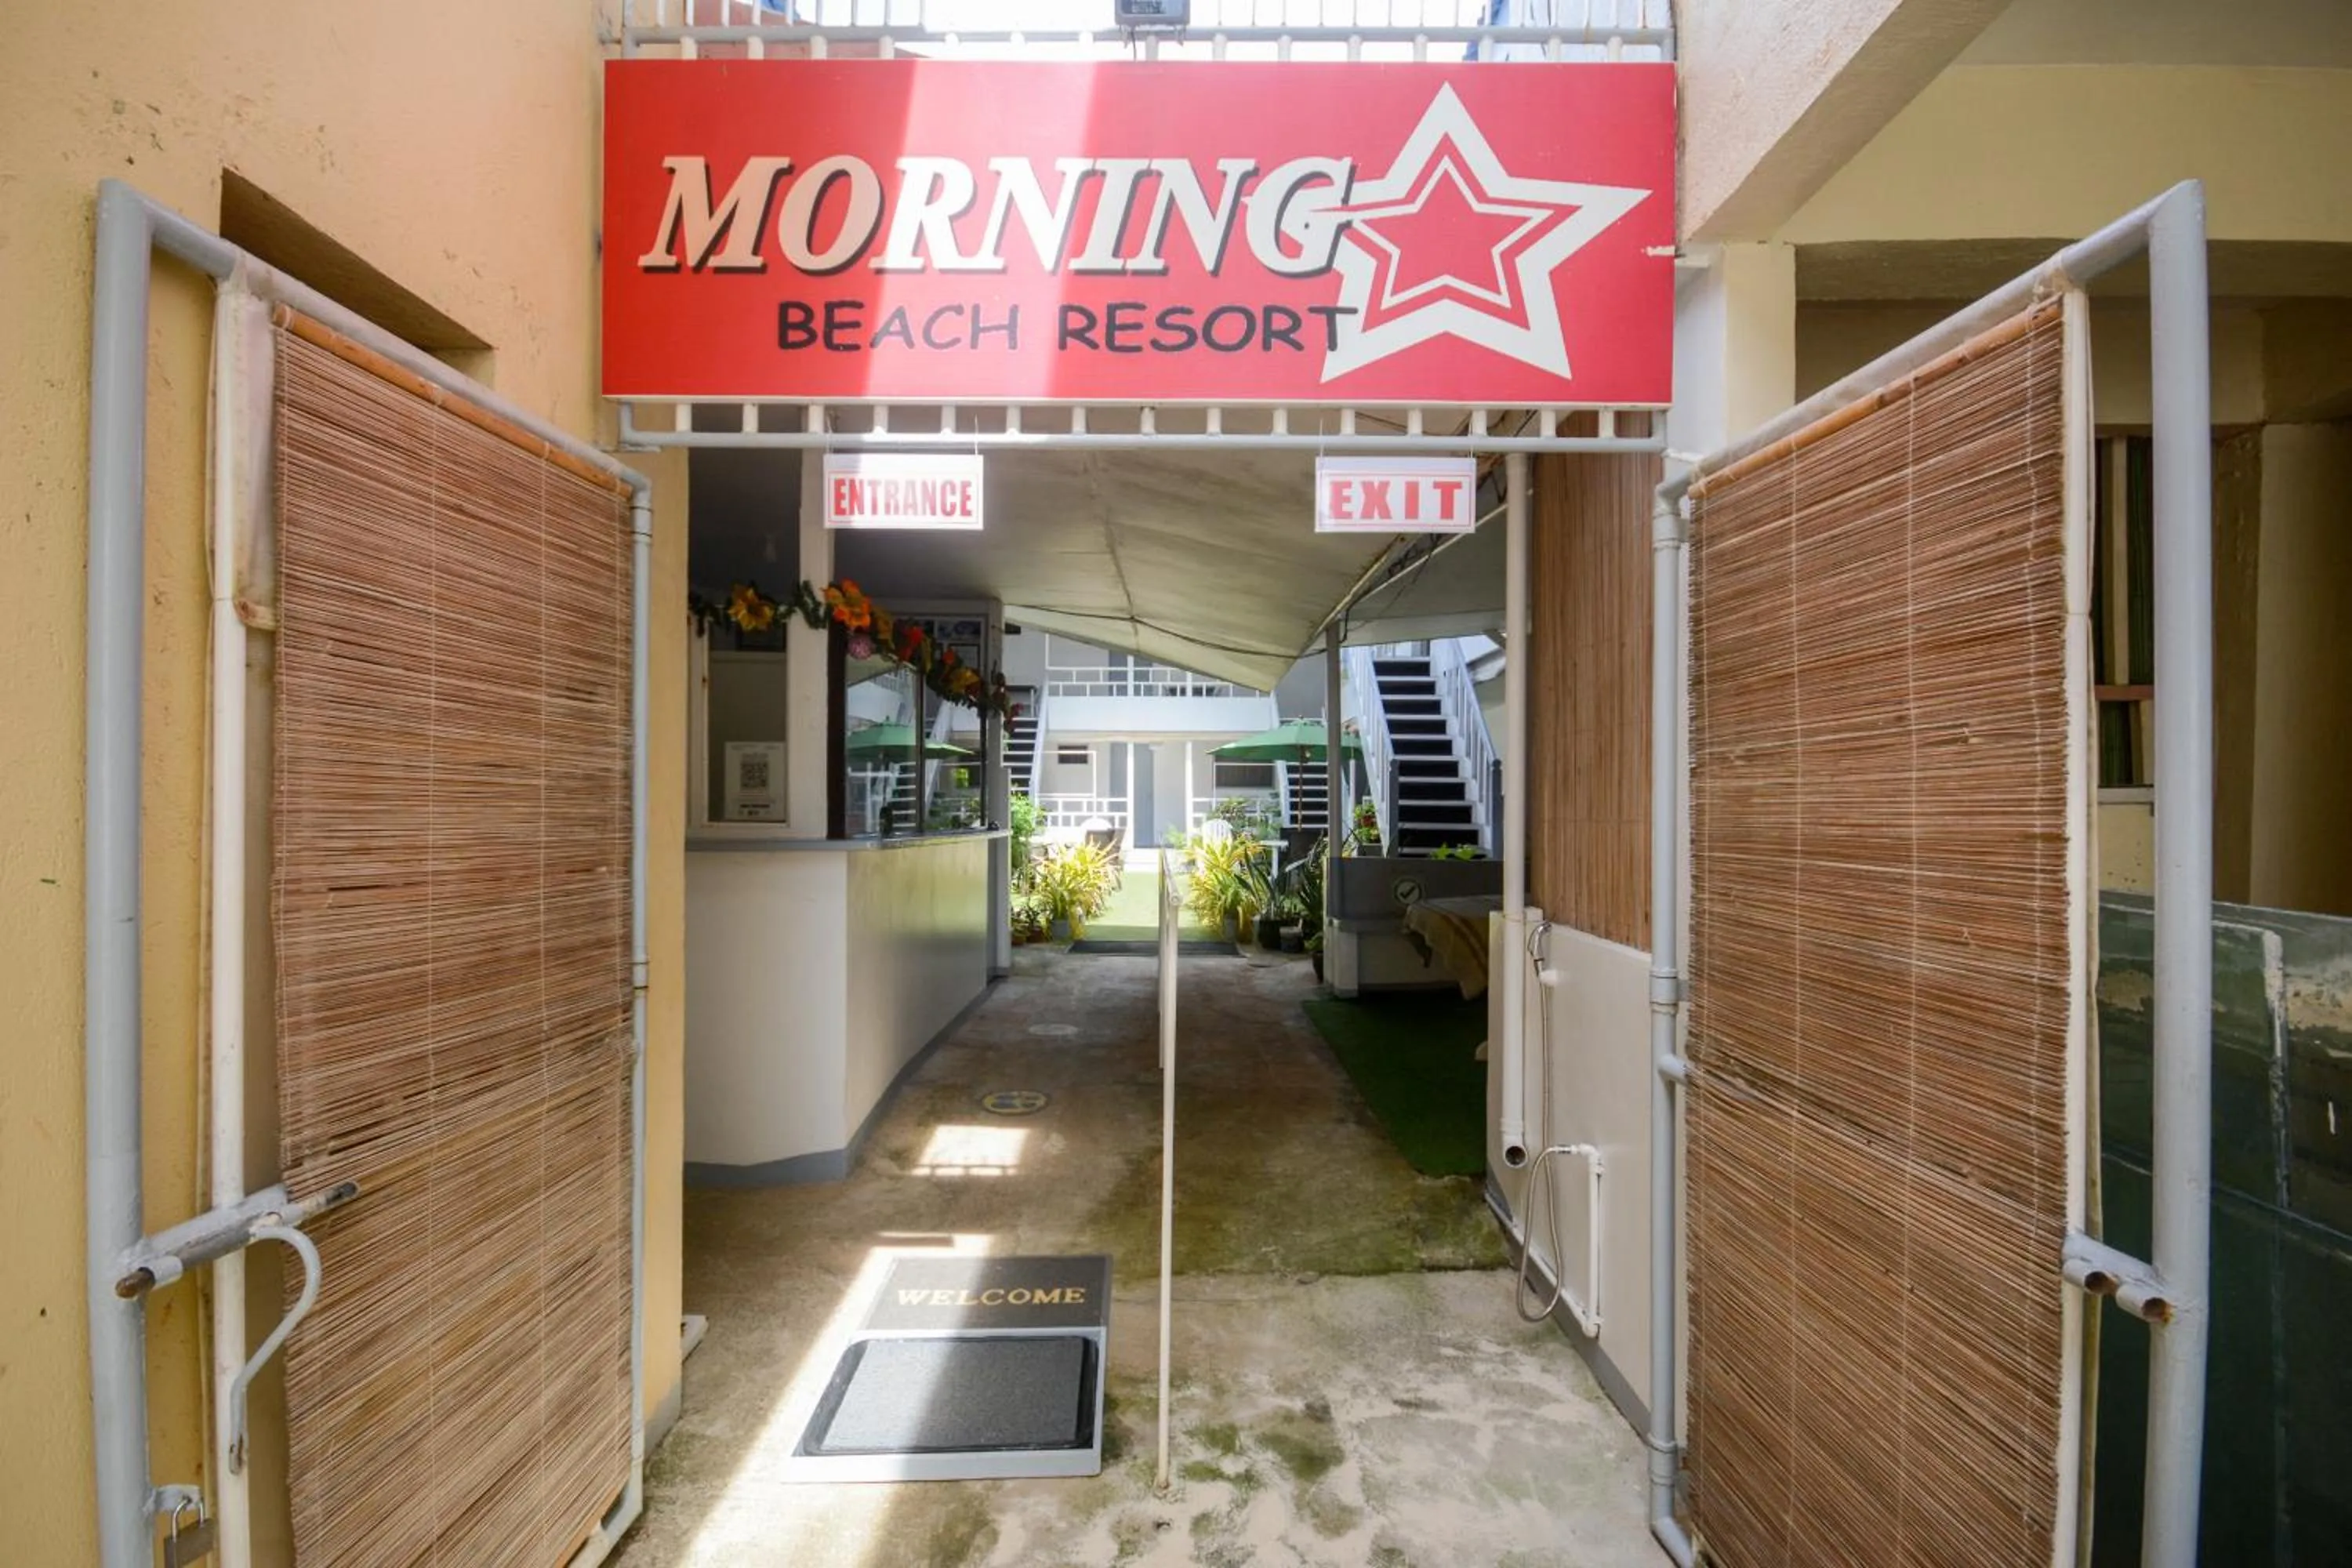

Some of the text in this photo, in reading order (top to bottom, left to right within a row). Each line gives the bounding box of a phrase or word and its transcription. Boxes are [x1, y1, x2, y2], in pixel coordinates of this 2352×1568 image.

[637, 154, 1356, 278] MORNING
[777, 300, 1359, 353] BEACH RESORT
[833, 477, 973, 517] ENTRANCE
[1330, 481, 1463, 520] EXIT
[897, 1287, 1086, 1305] WELCOME
